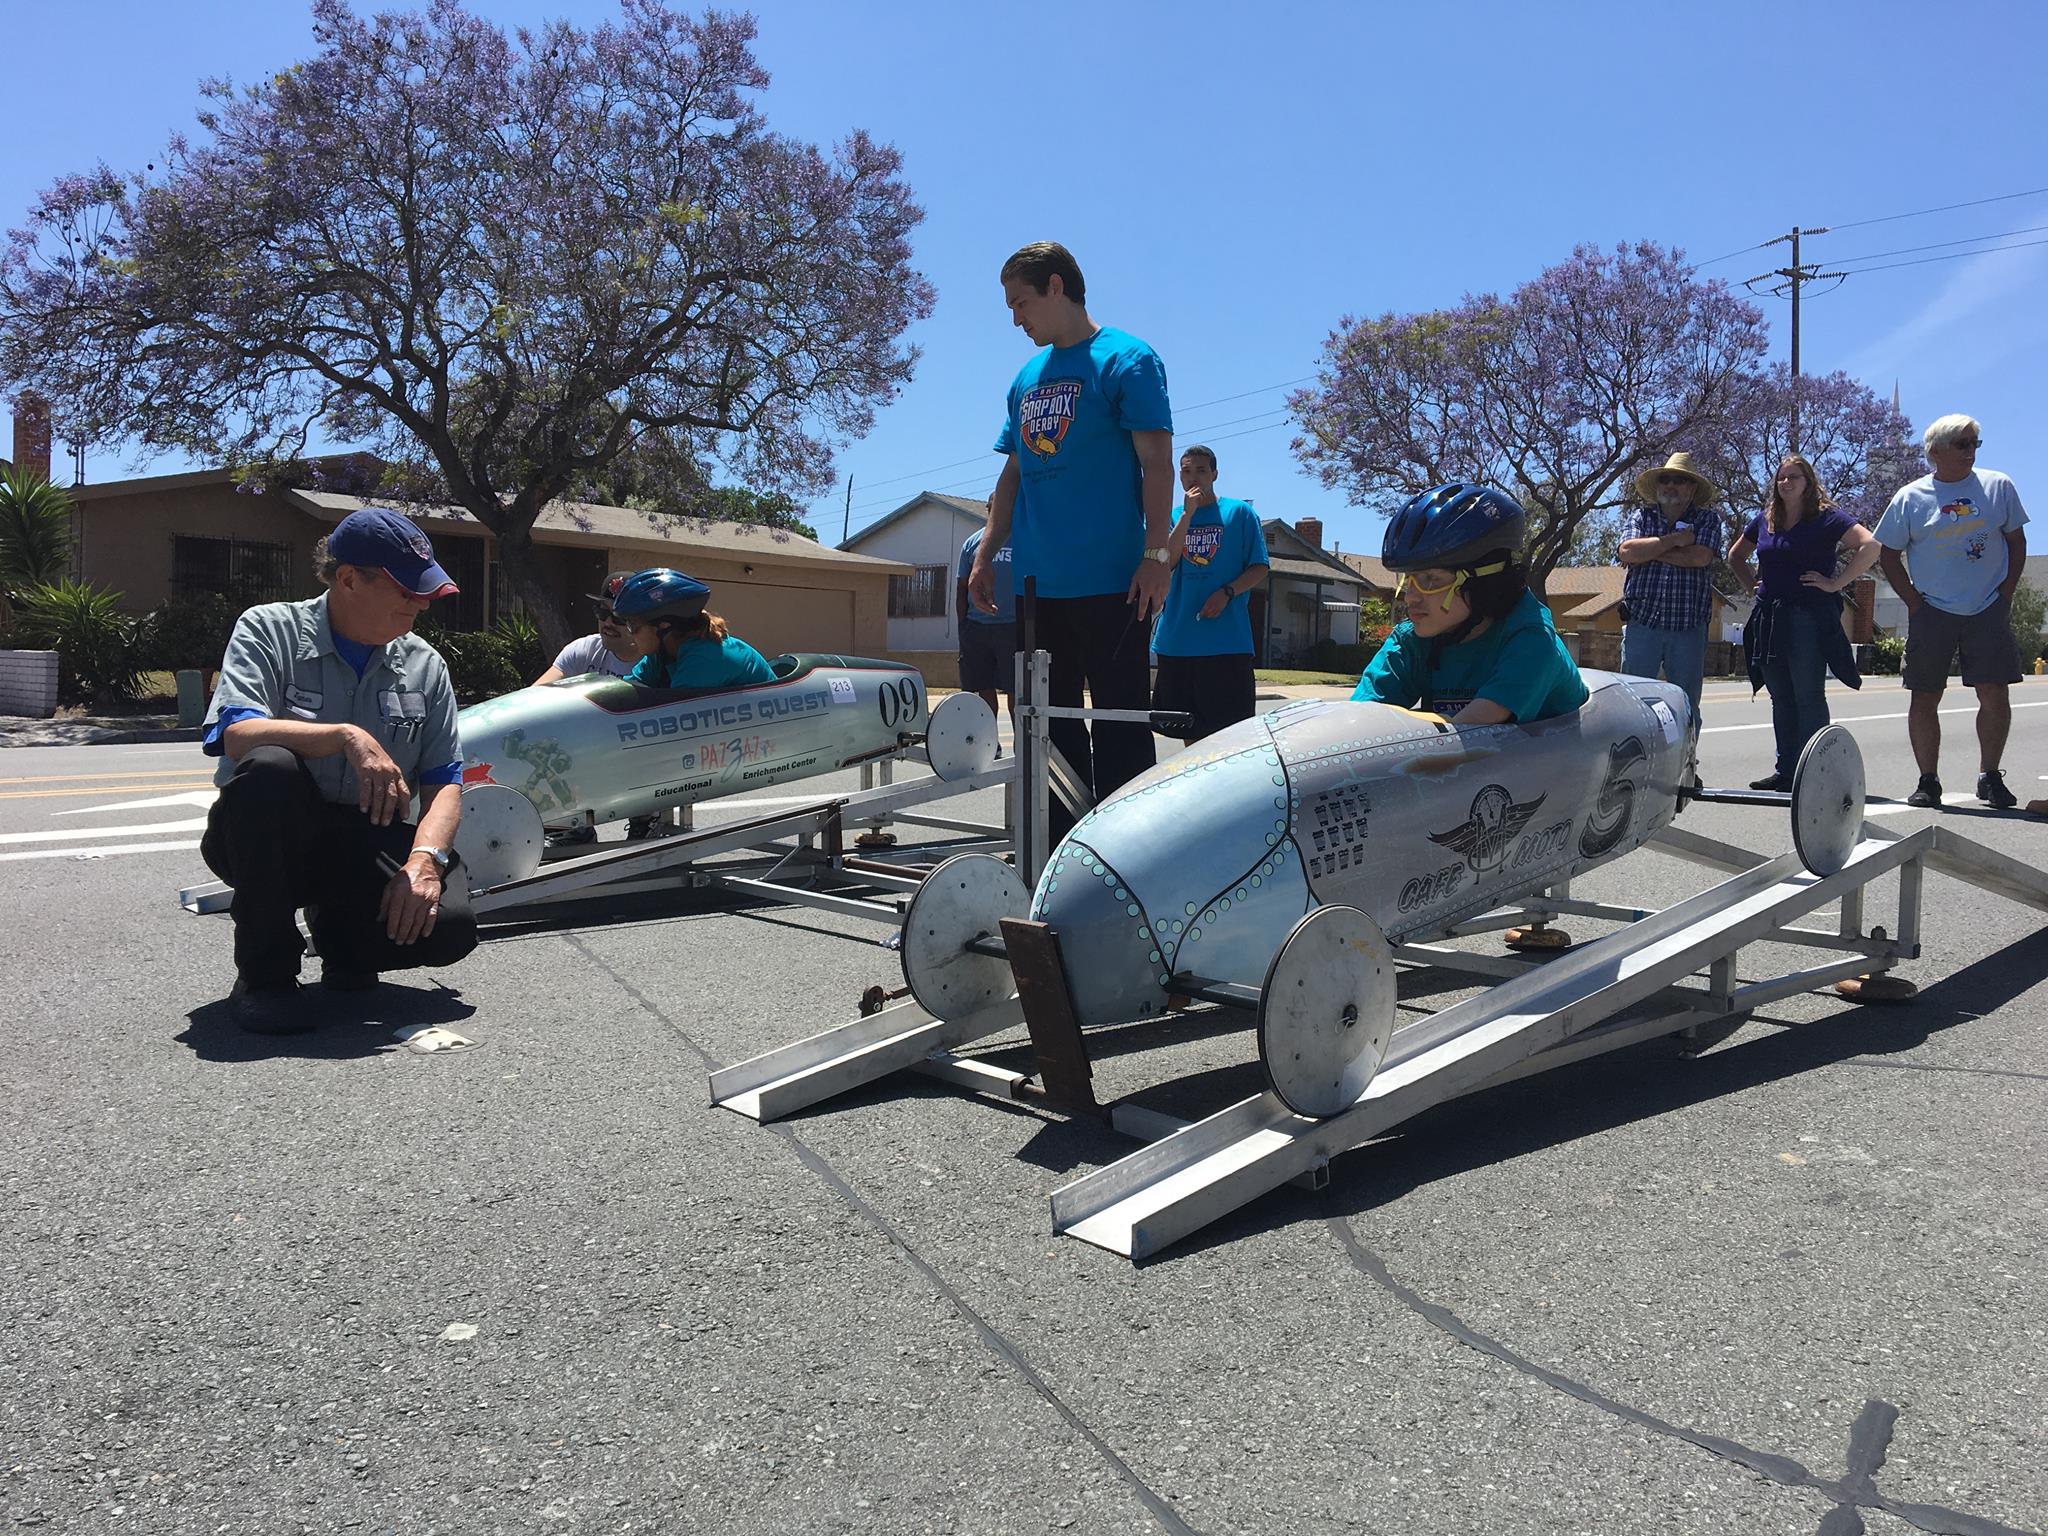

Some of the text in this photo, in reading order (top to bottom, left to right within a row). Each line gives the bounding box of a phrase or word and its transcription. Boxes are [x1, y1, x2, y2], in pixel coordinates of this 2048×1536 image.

[1030, 416, 1059, 433] DERBY
[1188, 545, 1210, 553] DERBY
[832, 681, 851, 692] 213
[879, 677, 919, 728] 09
[616, 703, 753, 742] ROBOTICS
[654, 757, 817, 798] Educational Enrichment Center
[1398, 818, 1574, 914] CAFE MOTO
